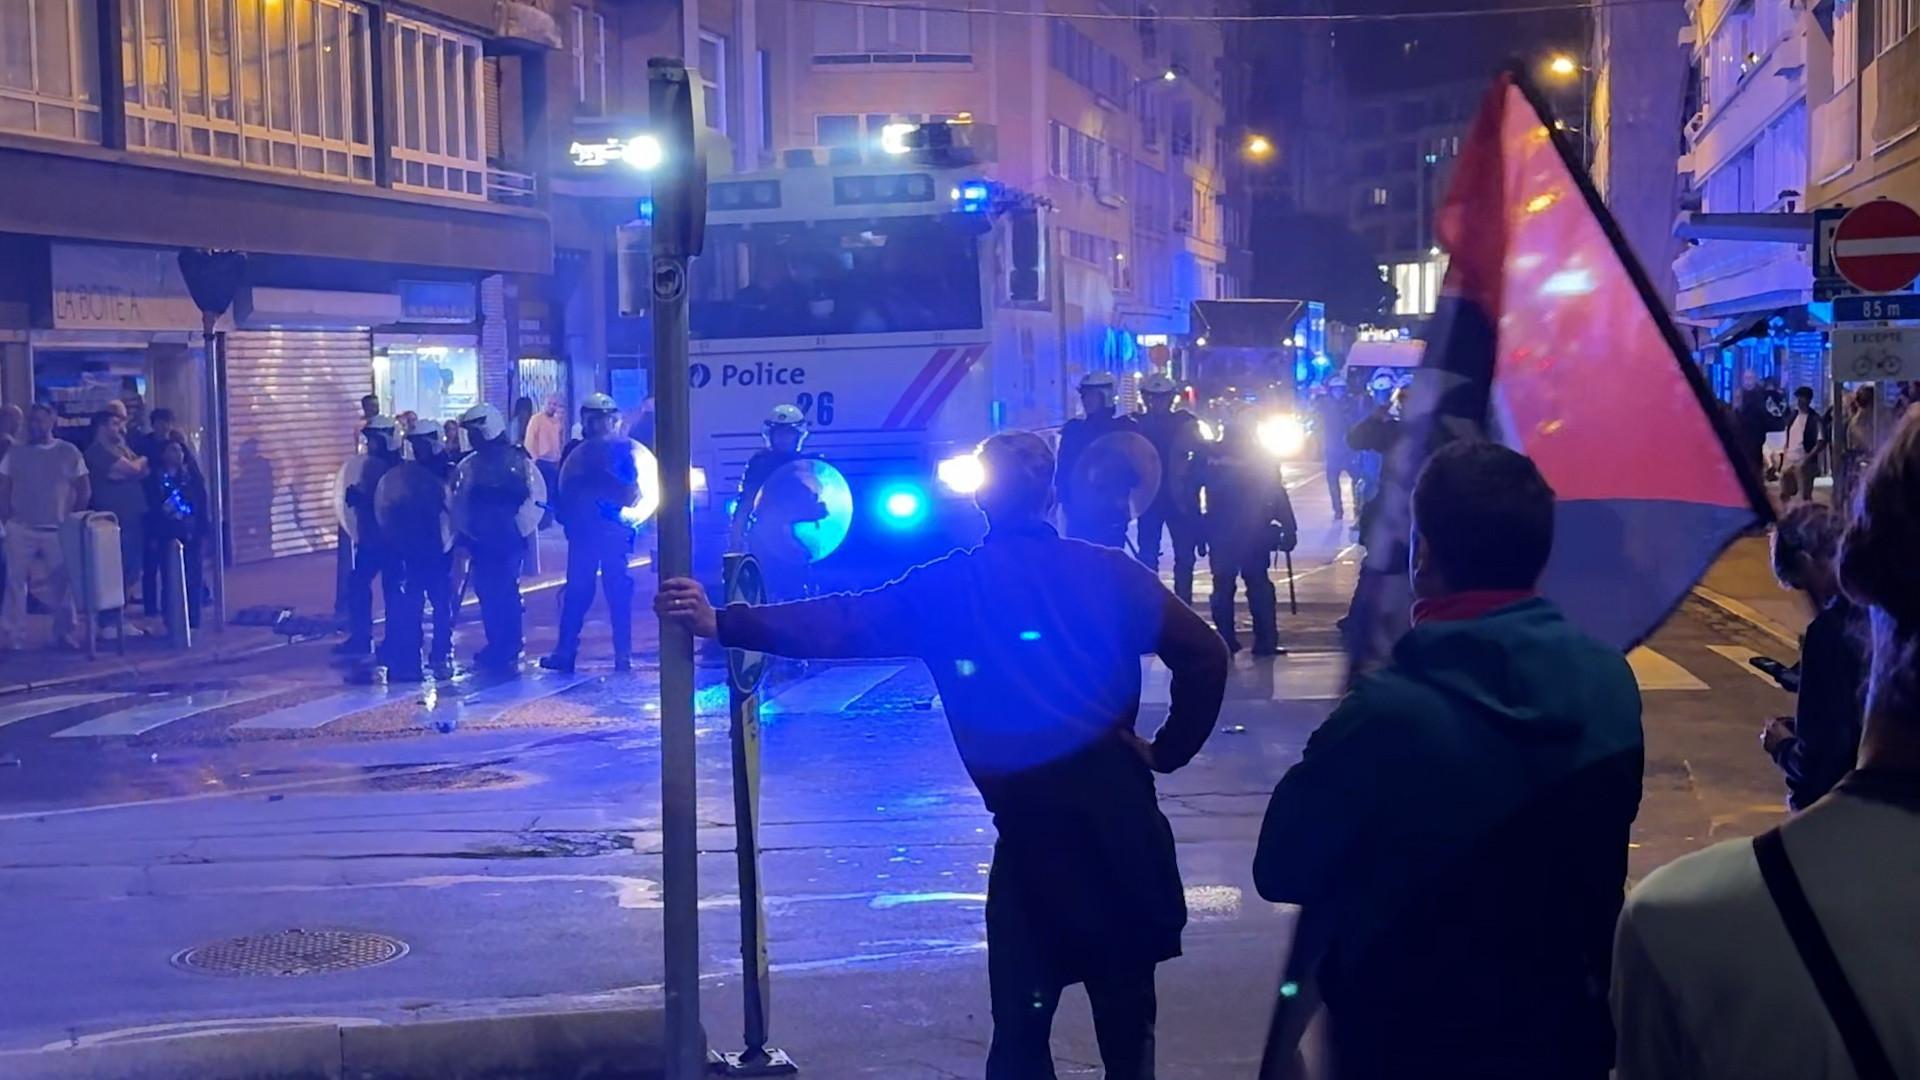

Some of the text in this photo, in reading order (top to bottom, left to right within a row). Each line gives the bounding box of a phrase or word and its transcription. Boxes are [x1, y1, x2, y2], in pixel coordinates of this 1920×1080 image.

[1862, 301, 1900, 317] 85 m
[722, 362, 806, 386] Police
[796, 391, 834, 426] 26
